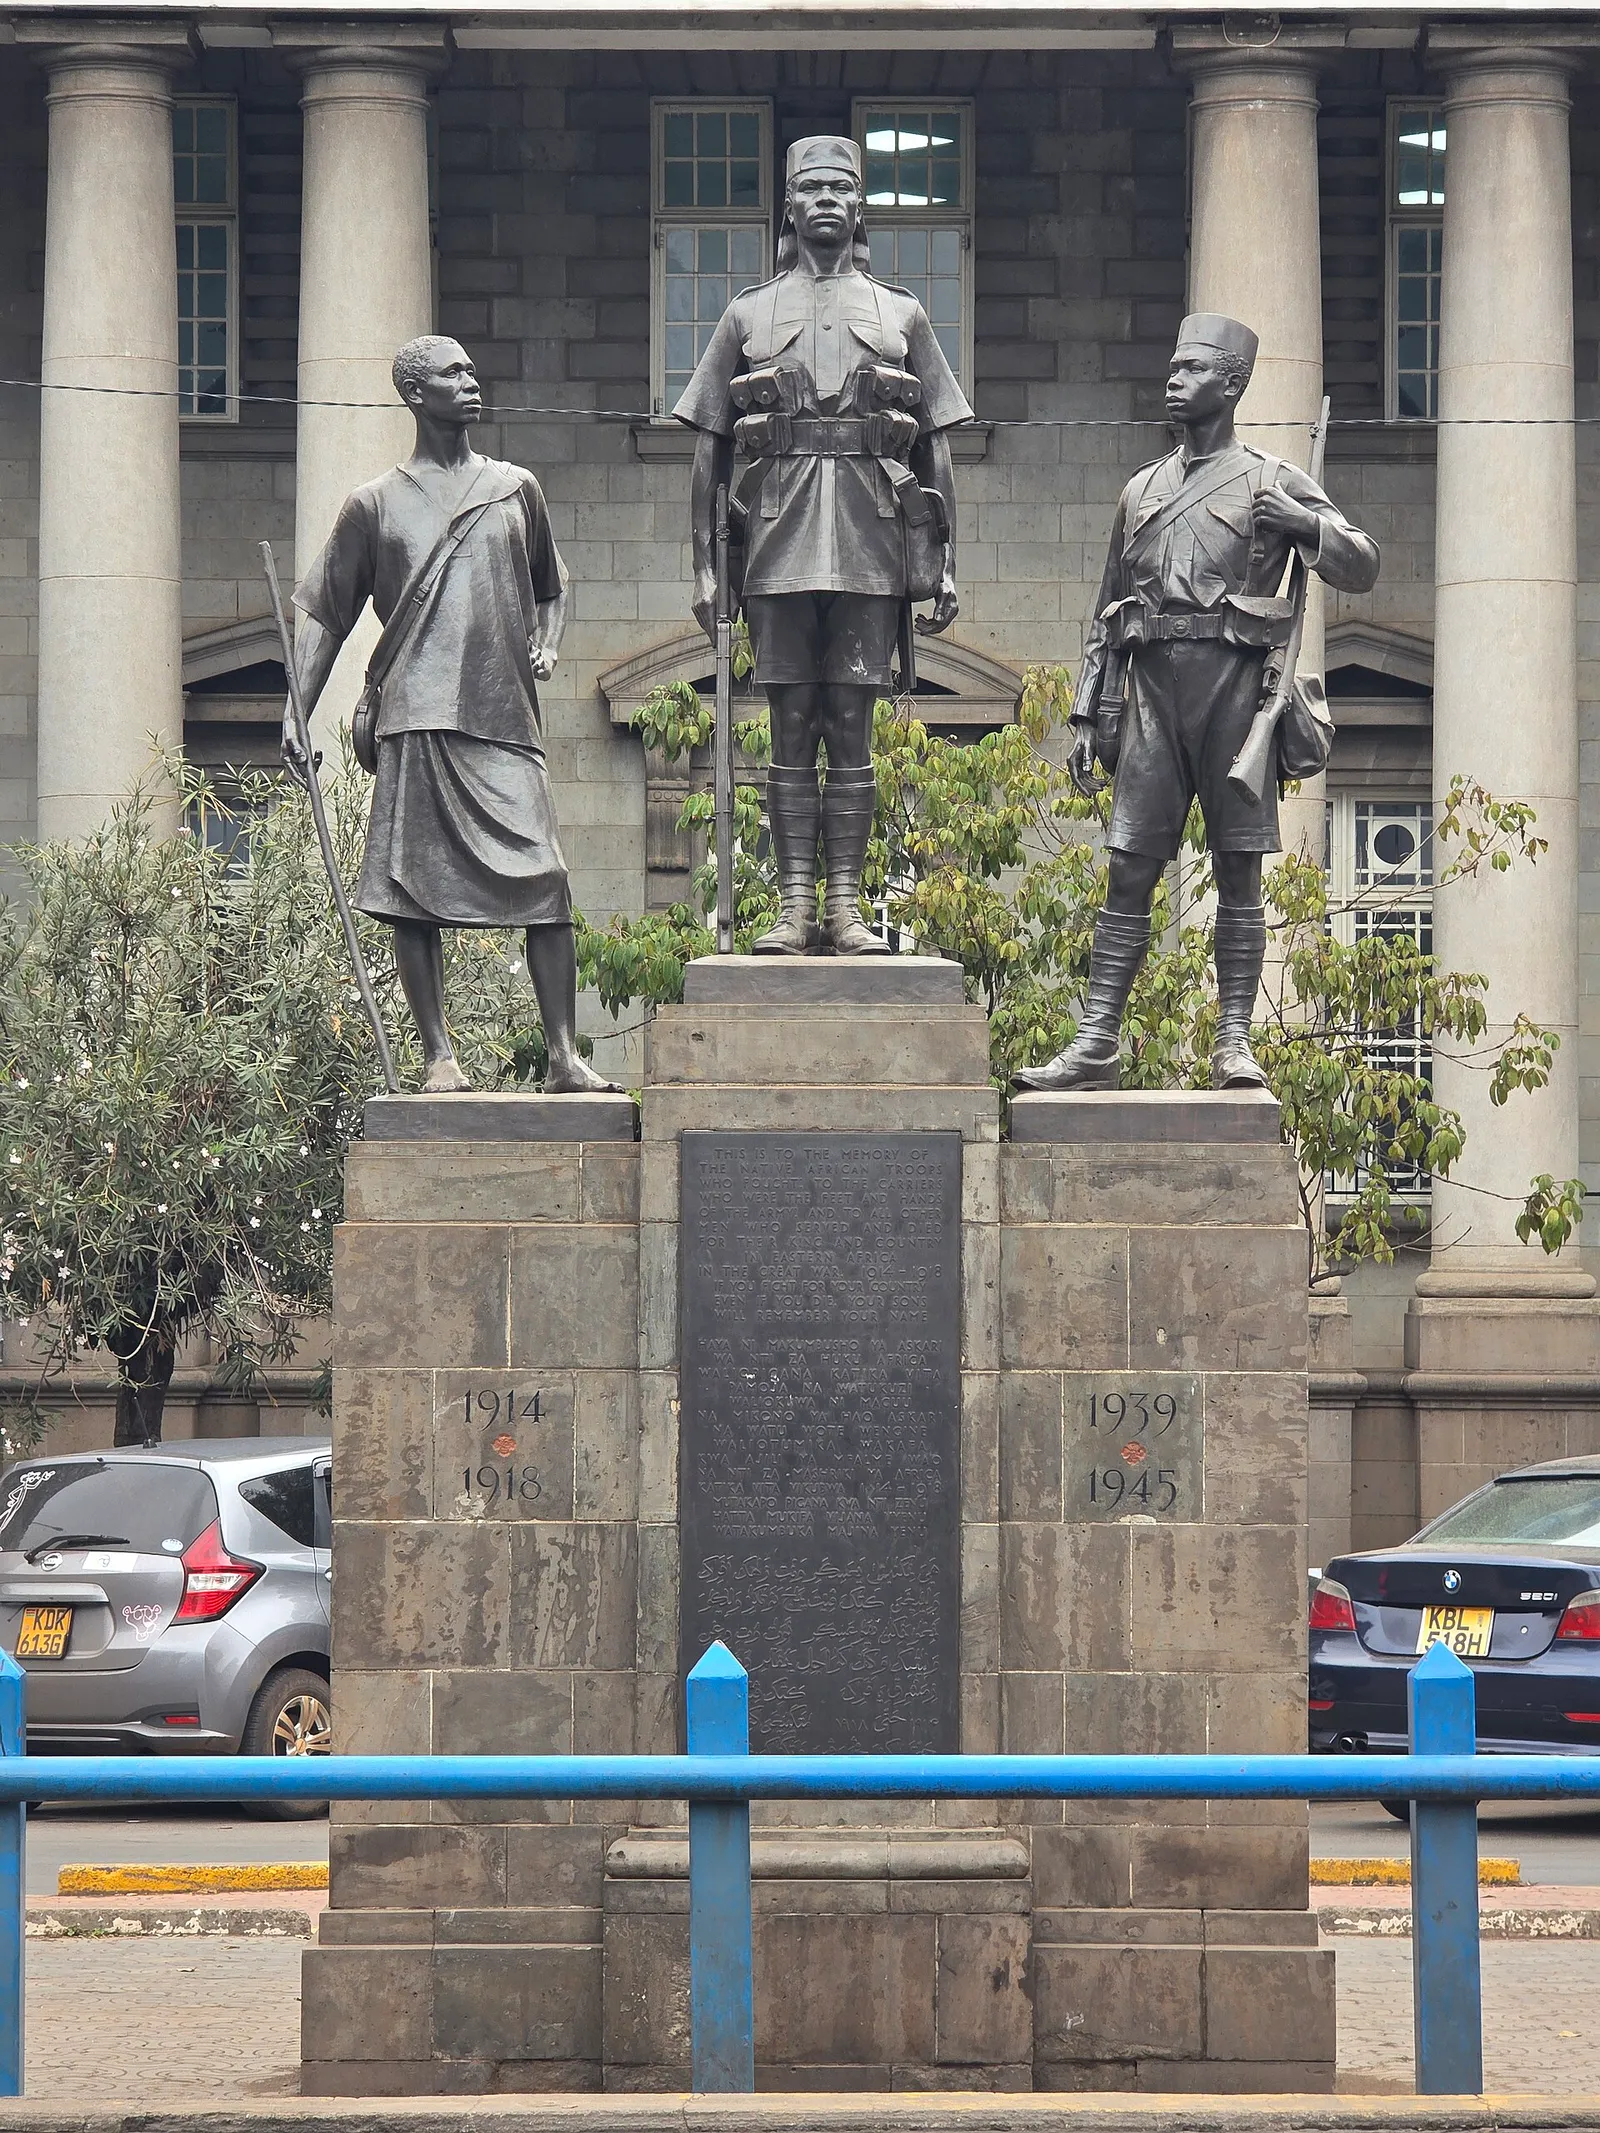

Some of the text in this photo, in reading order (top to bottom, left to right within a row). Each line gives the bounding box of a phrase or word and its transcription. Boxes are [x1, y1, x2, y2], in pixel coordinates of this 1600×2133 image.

[714, 1148, 929, 1160] THIS IS TO THE MEMORY OF
[700, 1163, 943, 1174] THE NATIVE AFRICAN TROOPS
[700, 1178, 732, 1189] WHO
[813, 1178, 832, 1189] TO
[842, 1178, 868, 1189] THE
[878, 1178, 943, 1189] CARRIERS
[700, 1192, 943, 1204] WHO WERE THE FEET AND HANDS
[700, 1207, 716, 1219] OF
[725, 1207, 748, 1219] THE
[808, 1207, 835, 1219] AND
[843, 1207, 861, 1219] TO
[869, 1207, 892, 1219] ALL
[901, 1207, 942, 1219] OTHER
[700, 1221, 943, 1233] MEN WHO SERVED AND DIED
[699, 1236, 942, 1248] FOR THEIR KING AND COUNTRY
[745, 1251, 897, 1263] IN EASTERN AFRICA
[699, 1265, 713, 1277] IN
[722, 1265, 748, 1277] THE
[759, 1265, 801, 1277] GREAT
[714, 1280, 926, 1291] IF YOU FIGHT FOR YOUR COUNTRY
[714, 1295, 746, 1307] EVEN
[756, 1295, 768, 1307] IF
[775, 1295, 804, 1307] YOU
[848, 1295, 885, 1307] YOUR
[893, 1295, 927, 1307] SONS
[714, 1310, 928, 1321] WILL REMEMBER YOUR NAME
[464, 1389, 545, 1431] 1914
[1089, 1391, 1177, 1438] 1939
[462, 1466, 541, 1506] 1918
[1089, 1467, 1177, 1512] 1945
[1428, 1607, 1469, 1630] KBL
[20, 1634, 62, 1653] 613G
